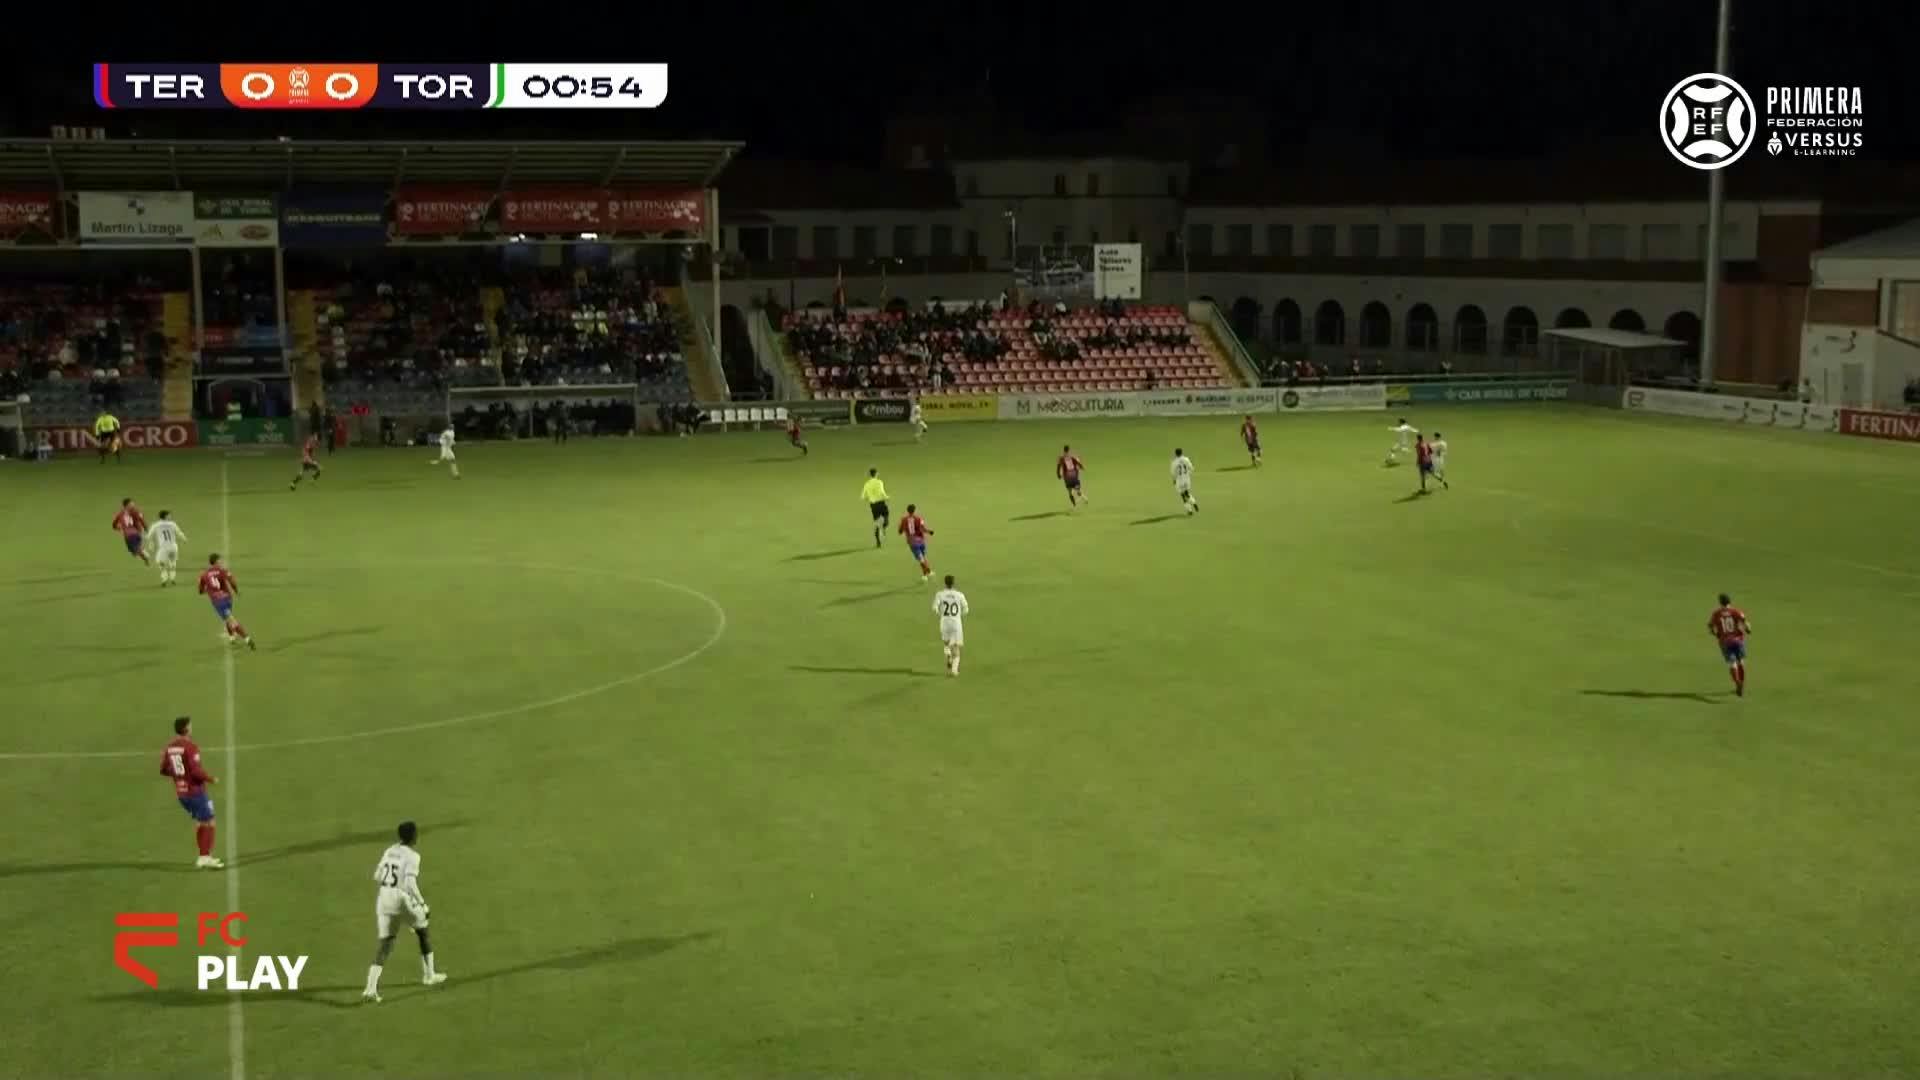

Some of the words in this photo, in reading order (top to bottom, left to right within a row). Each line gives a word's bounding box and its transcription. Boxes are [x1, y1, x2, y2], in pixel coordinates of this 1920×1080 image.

[140, 222, 183, 235] Lizaga
[943, 600, 959, 617] 20
[382, 862, 399, 888] 25
